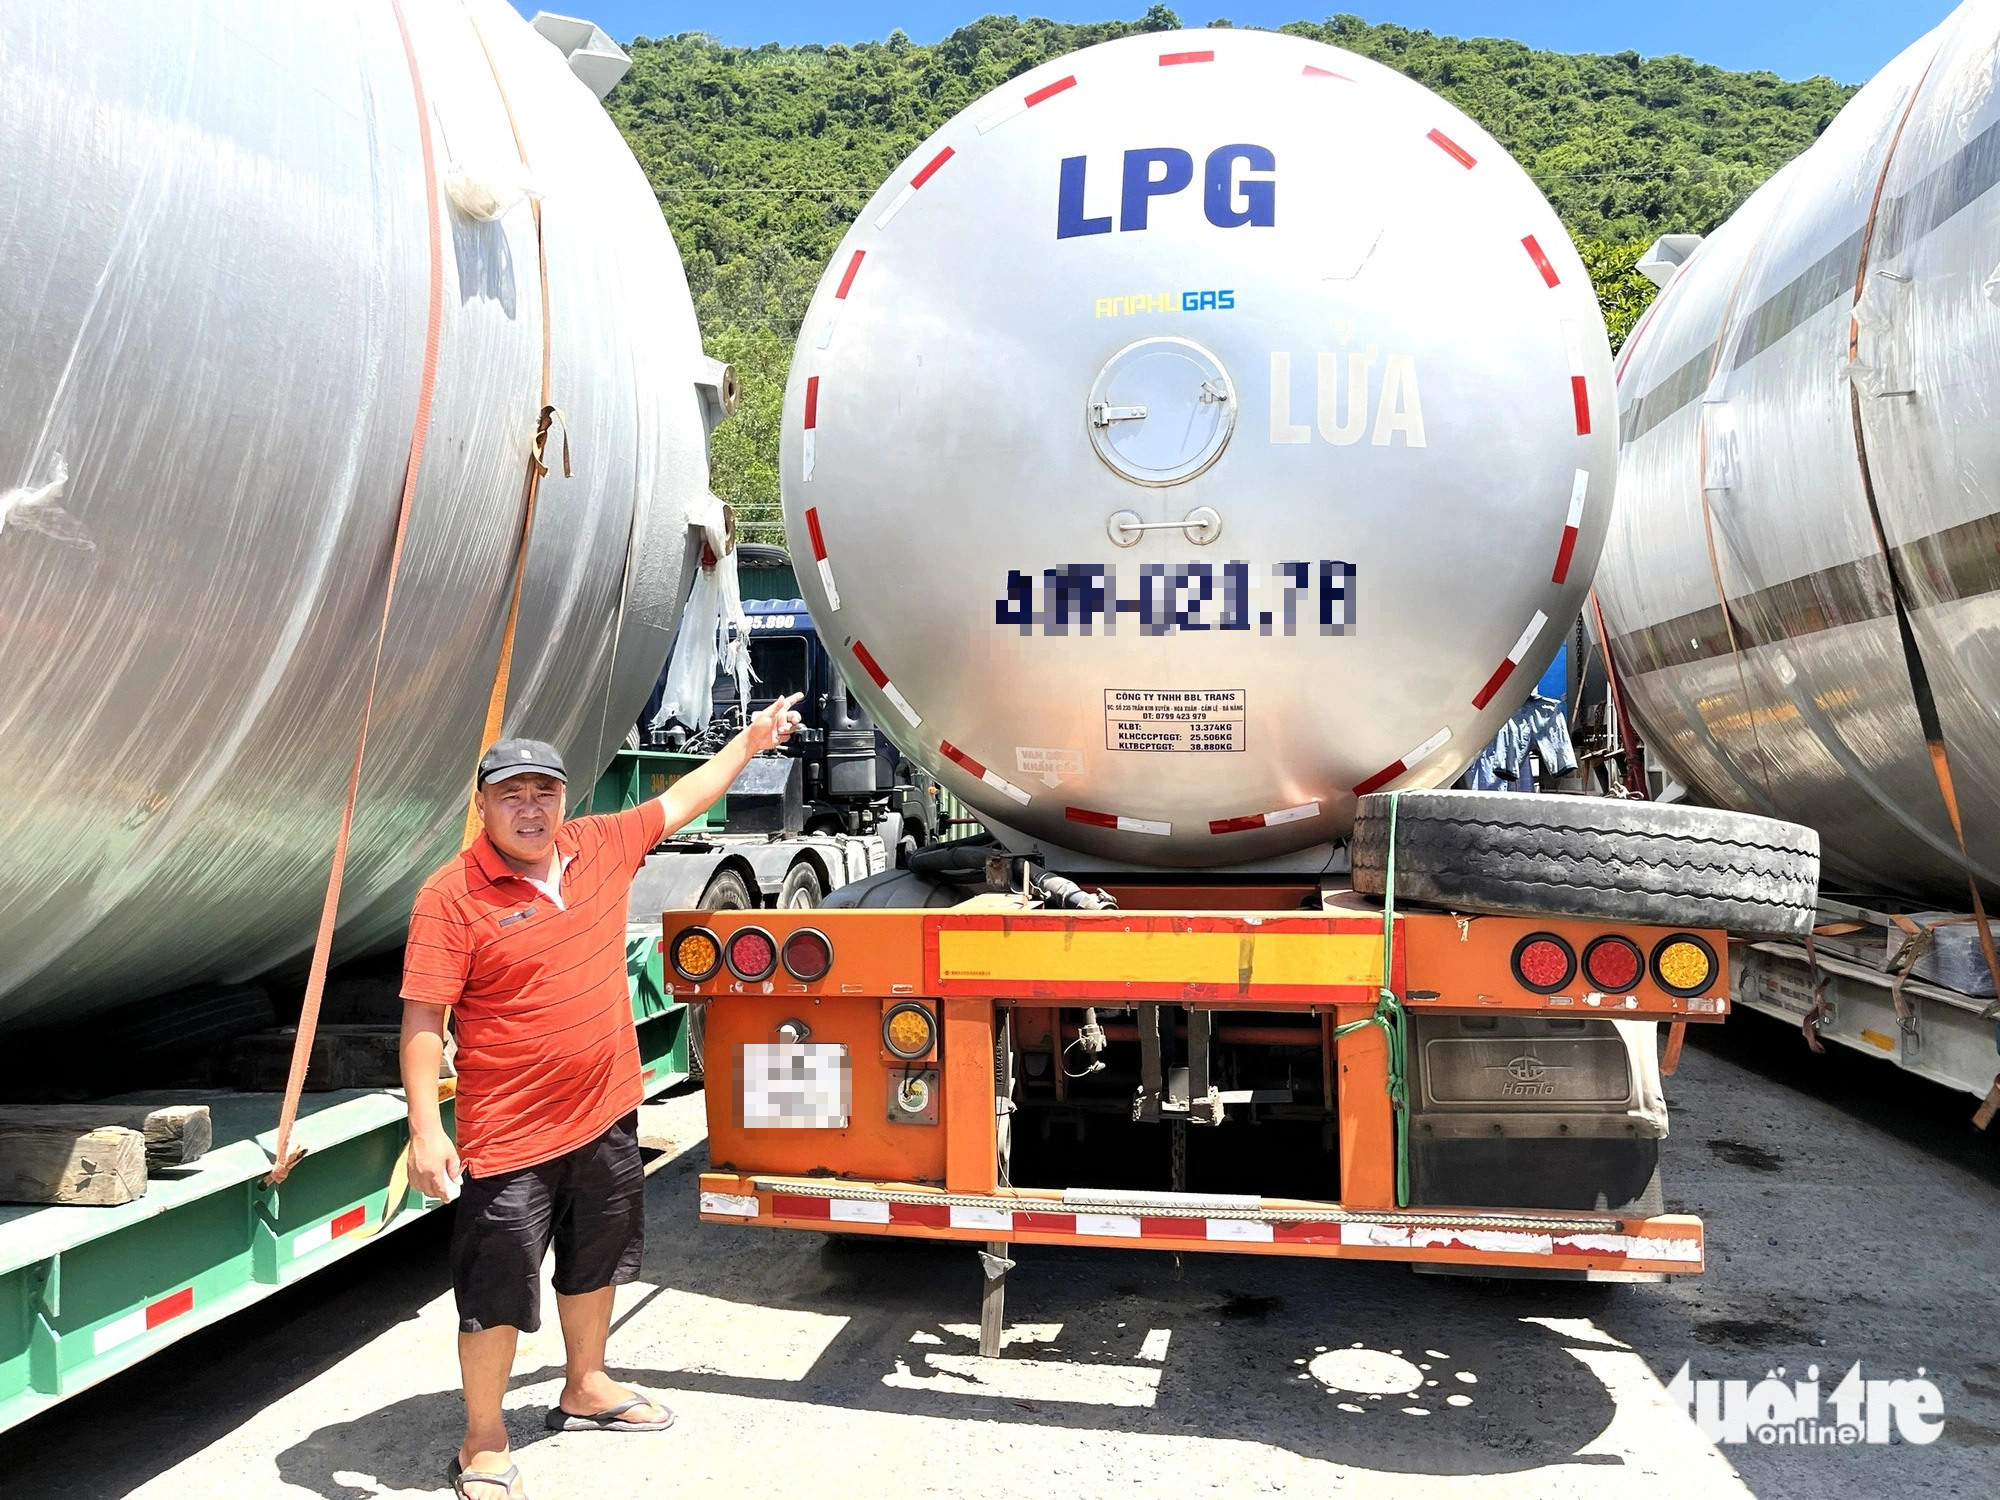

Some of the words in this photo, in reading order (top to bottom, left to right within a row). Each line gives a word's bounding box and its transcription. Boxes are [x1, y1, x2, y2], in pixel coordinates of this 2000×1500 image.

[1057, 143, 1276, 240] LPG
[1270, 318, 1427, 448] LỬA
[1115, 692, 1141, 701] CÔNG
[1144, 693, 1154, 701] TY
[1157, 693, 1181, 701] TNHH
[1184, 693, 1202, 701] BBL
[1205, 693, 1235, 701] TRANS
[1118, 722, 1142, 731] KLBT:
[1190, 723, 1232, 731] 13.374KG
[1118, 732, 1182, 741] KLHCCCPTGGT:
[1119, 742, 1175, 750] KLTBCPTGGT:
